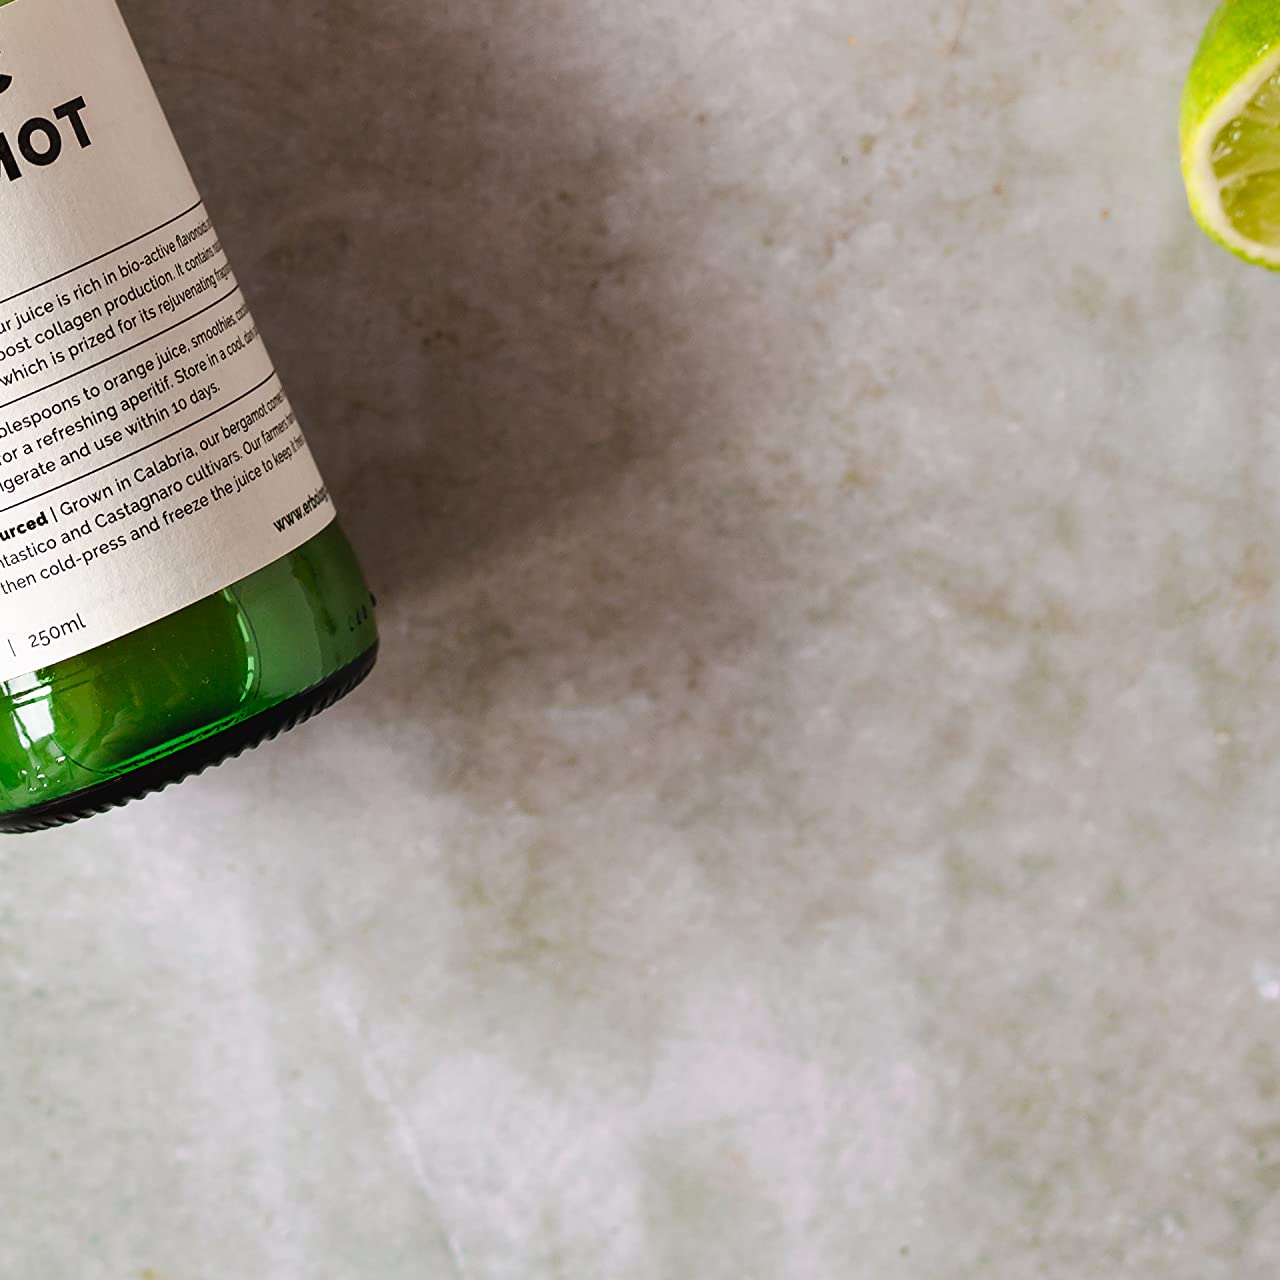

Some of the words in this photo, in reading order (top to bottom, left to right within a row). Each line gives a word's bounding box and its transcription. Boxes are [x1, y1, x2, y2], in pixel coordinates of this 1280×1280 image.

[14, 301, 54, 330] juice
[55, 293, 71, 308] is
[72, 277, 102, 300] rich
[101, 271, 118, 286] in
[117, 241, 176, 278] bio-active
[34, 306, 102, 344] collagen
[103, 271, 176, 317] production.
[174, 262, 185, 277] It
[49, 351, 65, 365] is
[67, 324, 116, 361] prized
[117, 315, 137, 334] for
[138, 307, 157, 323] its
[157, 274, 217, 314] rejuvenating
[22, 443, 34, 455] a
[35, 405, 118, 449] refreshing
[119, 374, 174, 411] aperitif.
[173, 360, 207, 384] Store
[205, 353, 219, 367] in
[218, 349, 227, 360] a
[82, 385, 100, 401] to
[103, 360, 155, 391] orange
[154, 343, 191, 370] juice,
[59, 441, 92, 466] and
[93, 430, 123, 451] use
[124, 407, 170, 436] within
[171, 398, 188, 414] 10
[189, 382, 220, 404] days.
[59, 486, 114, 516] Grown
[114, 477, 132, 492] in
[133, 447, 198, 482] Calabria,
[199, 431, 220, 451] our
[220, 402, 268, 439] bergamot
[0, 573, 37, 595] then
[39, 535, 127, 579] cold-press
[129, 515, 161, 541] and
[161, 495, 209, 526] freeze
[209, 482, 234, 501] the
[232, 466, 262, 493] juice
[260, 459, 274, 473] to
[271, 446, 292, 466] keep
[60, 519, 92, 544] and
[94, 480, 183, 528] Castagnaro
[185, 450, 243, 486] cultivars.
[242, 436, 262, 455] Our
[272, 484, 331, 533] www.erbolog
[28, 612, 86, 648] 250ml
